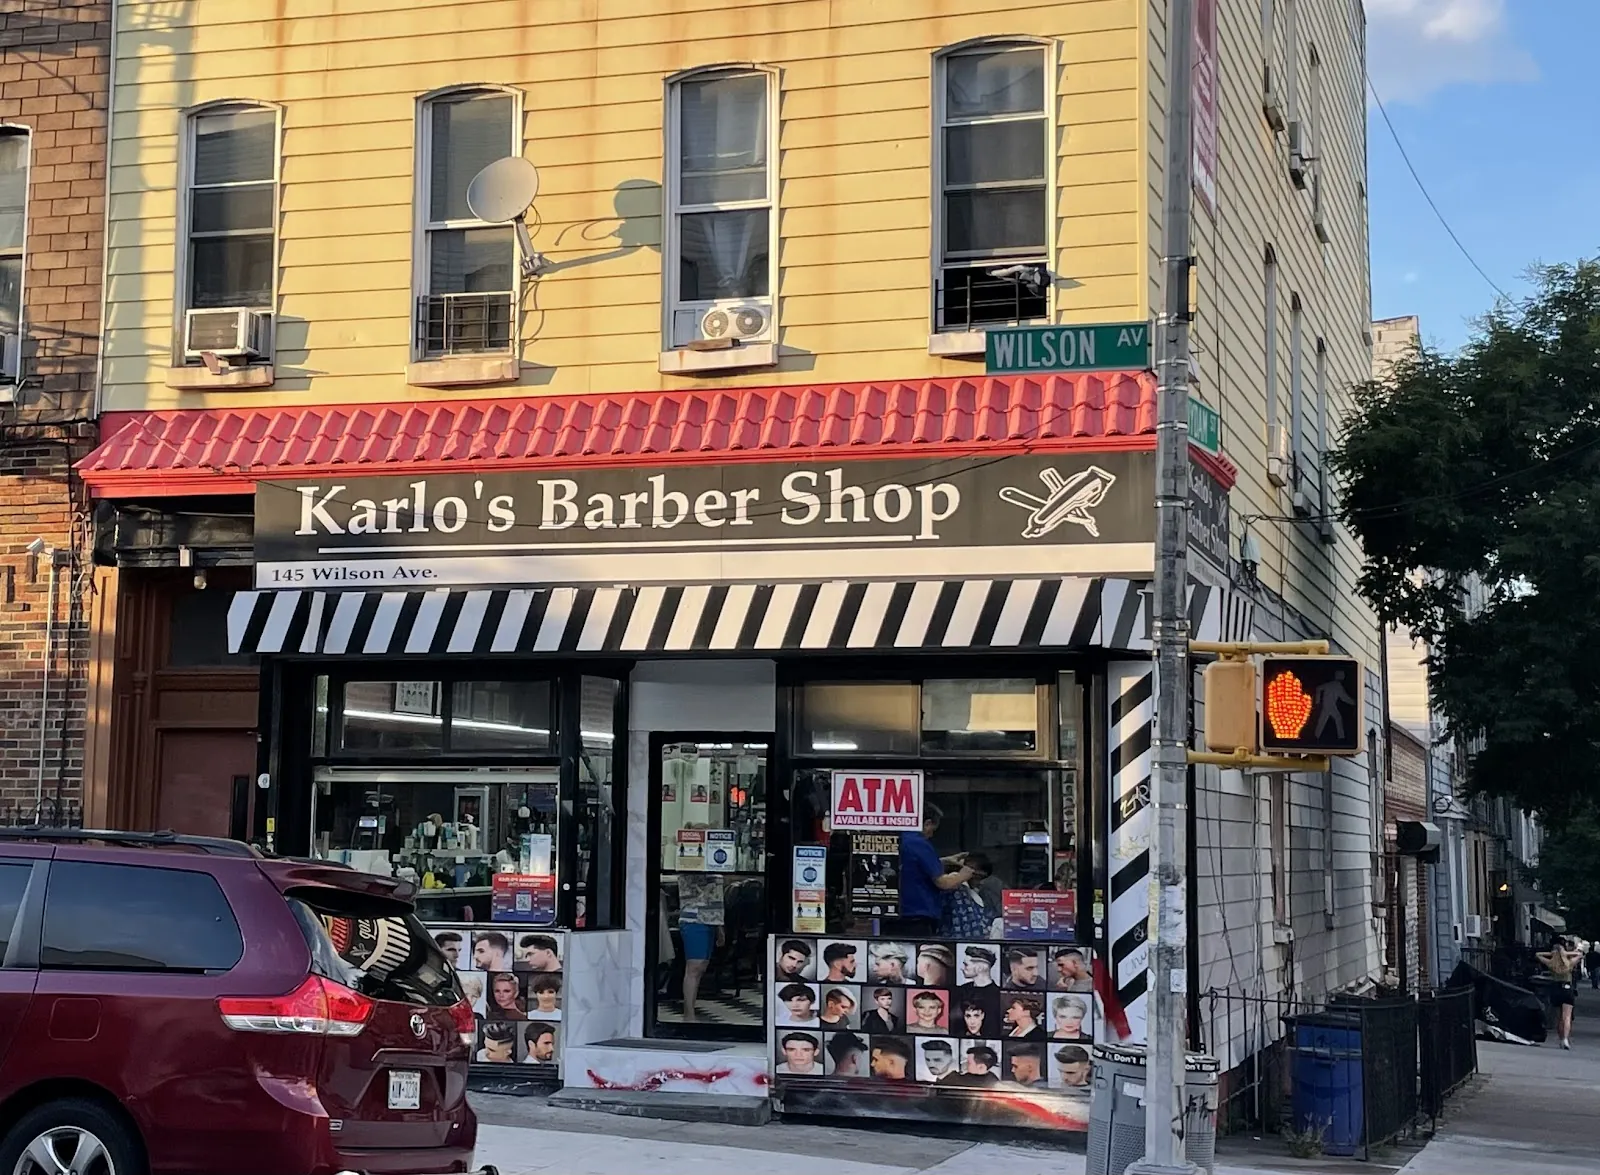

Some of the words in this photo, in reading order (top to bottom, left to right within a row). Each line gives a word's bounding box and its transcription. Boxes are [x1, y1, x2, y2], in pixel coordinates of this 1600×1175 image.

[994, 330, 1096, 369] WILSON
[1116, 328, 1144, 348] AV
[295, 480, 517, 537] Karlo's
[537, 473, 762, 531] Barber
[779, 467, 961, 541] Shop
[271, 568, 304, 582] 145
[312, 566, 384, 581] Wilson
[392, 564, 438, 579] Ave.
[838, 778, 915, 813] ATM
[835, 815, 885, 825] AVAILABLE
[886, 817, 918, 826] INSIDE
[853, 843, 899, 852] LOUNGE
[1113, 1054, 1137, 1064] Don't
